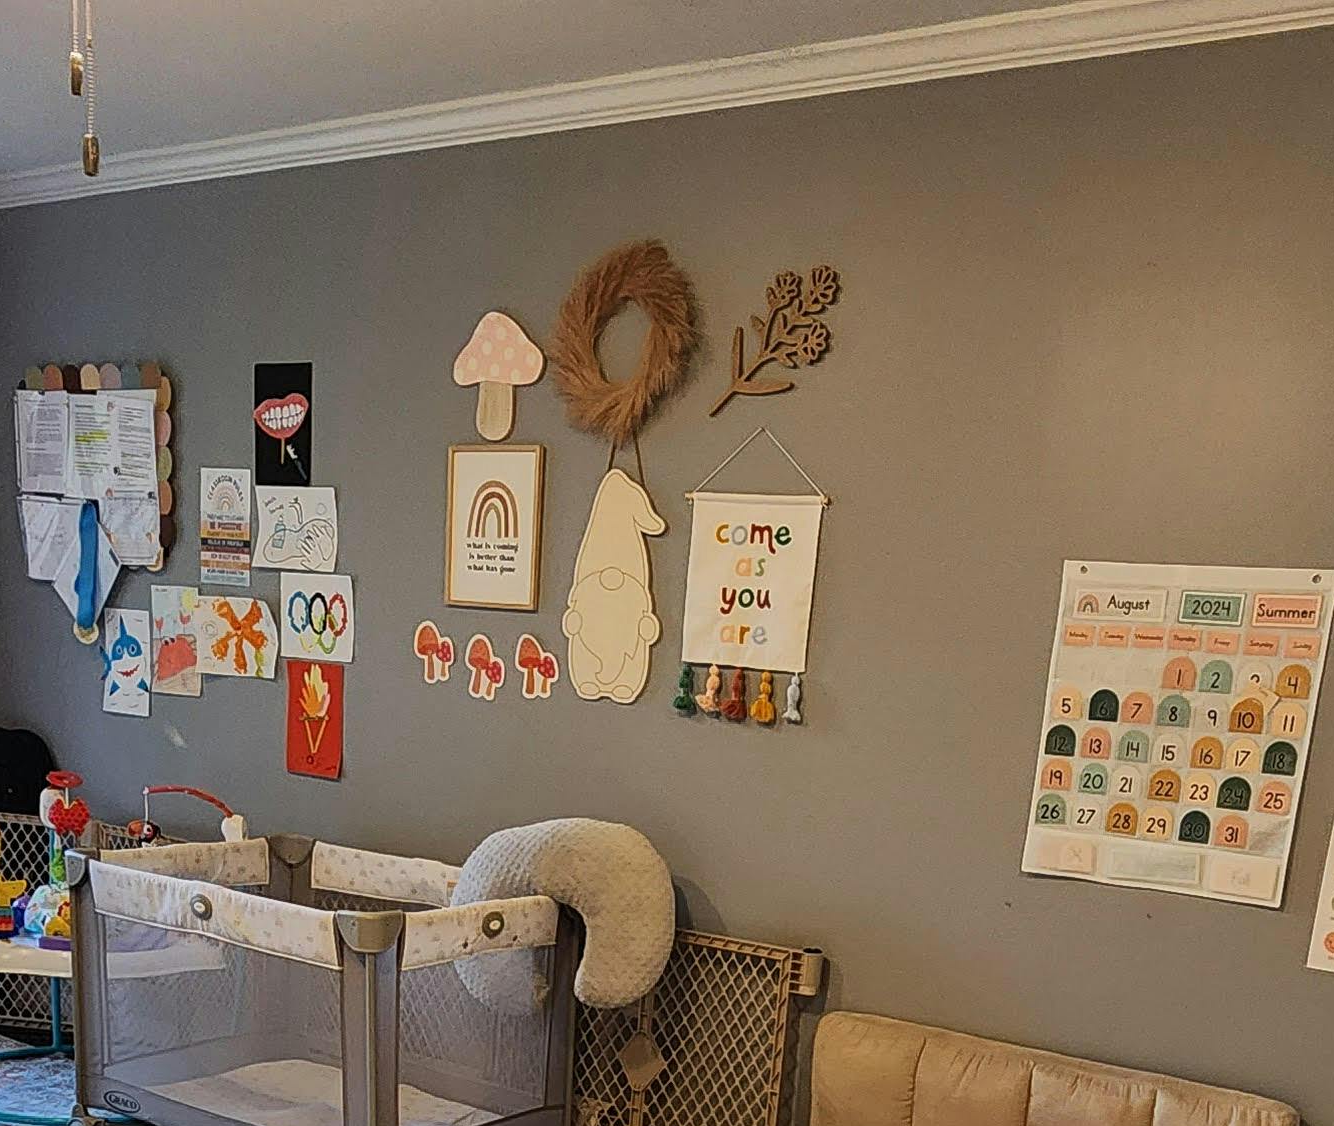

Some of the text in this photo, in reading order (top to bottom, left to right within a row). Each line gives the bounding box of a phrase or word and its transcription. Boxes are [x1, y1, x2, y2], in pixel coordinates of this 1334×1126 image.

[715, 523, 792, 555] come
[735, 557, 766, 577] as
[719, 587, 772, 615] you
[1107, 595, 1316, 619] August 2024 Summer
[720, 625, 768, 645] are
[1176, 669, 1182, 686] 1
[1210, 672, 1221, 688] 2
[1287, 677, 1299, 694] 4
[1062, 697, 1295, 732] 5 6 7 8 9 10 11
[1053, 737, 1286, 769] 12 13 14 15 16 17 18
[1049, 770, 1286, 810] 19 20 21 22 23 24 25
[1041, 804, 1239, 843] 26 27 28 29 30 31
[108, 1094, 137, 1109] GRACO
